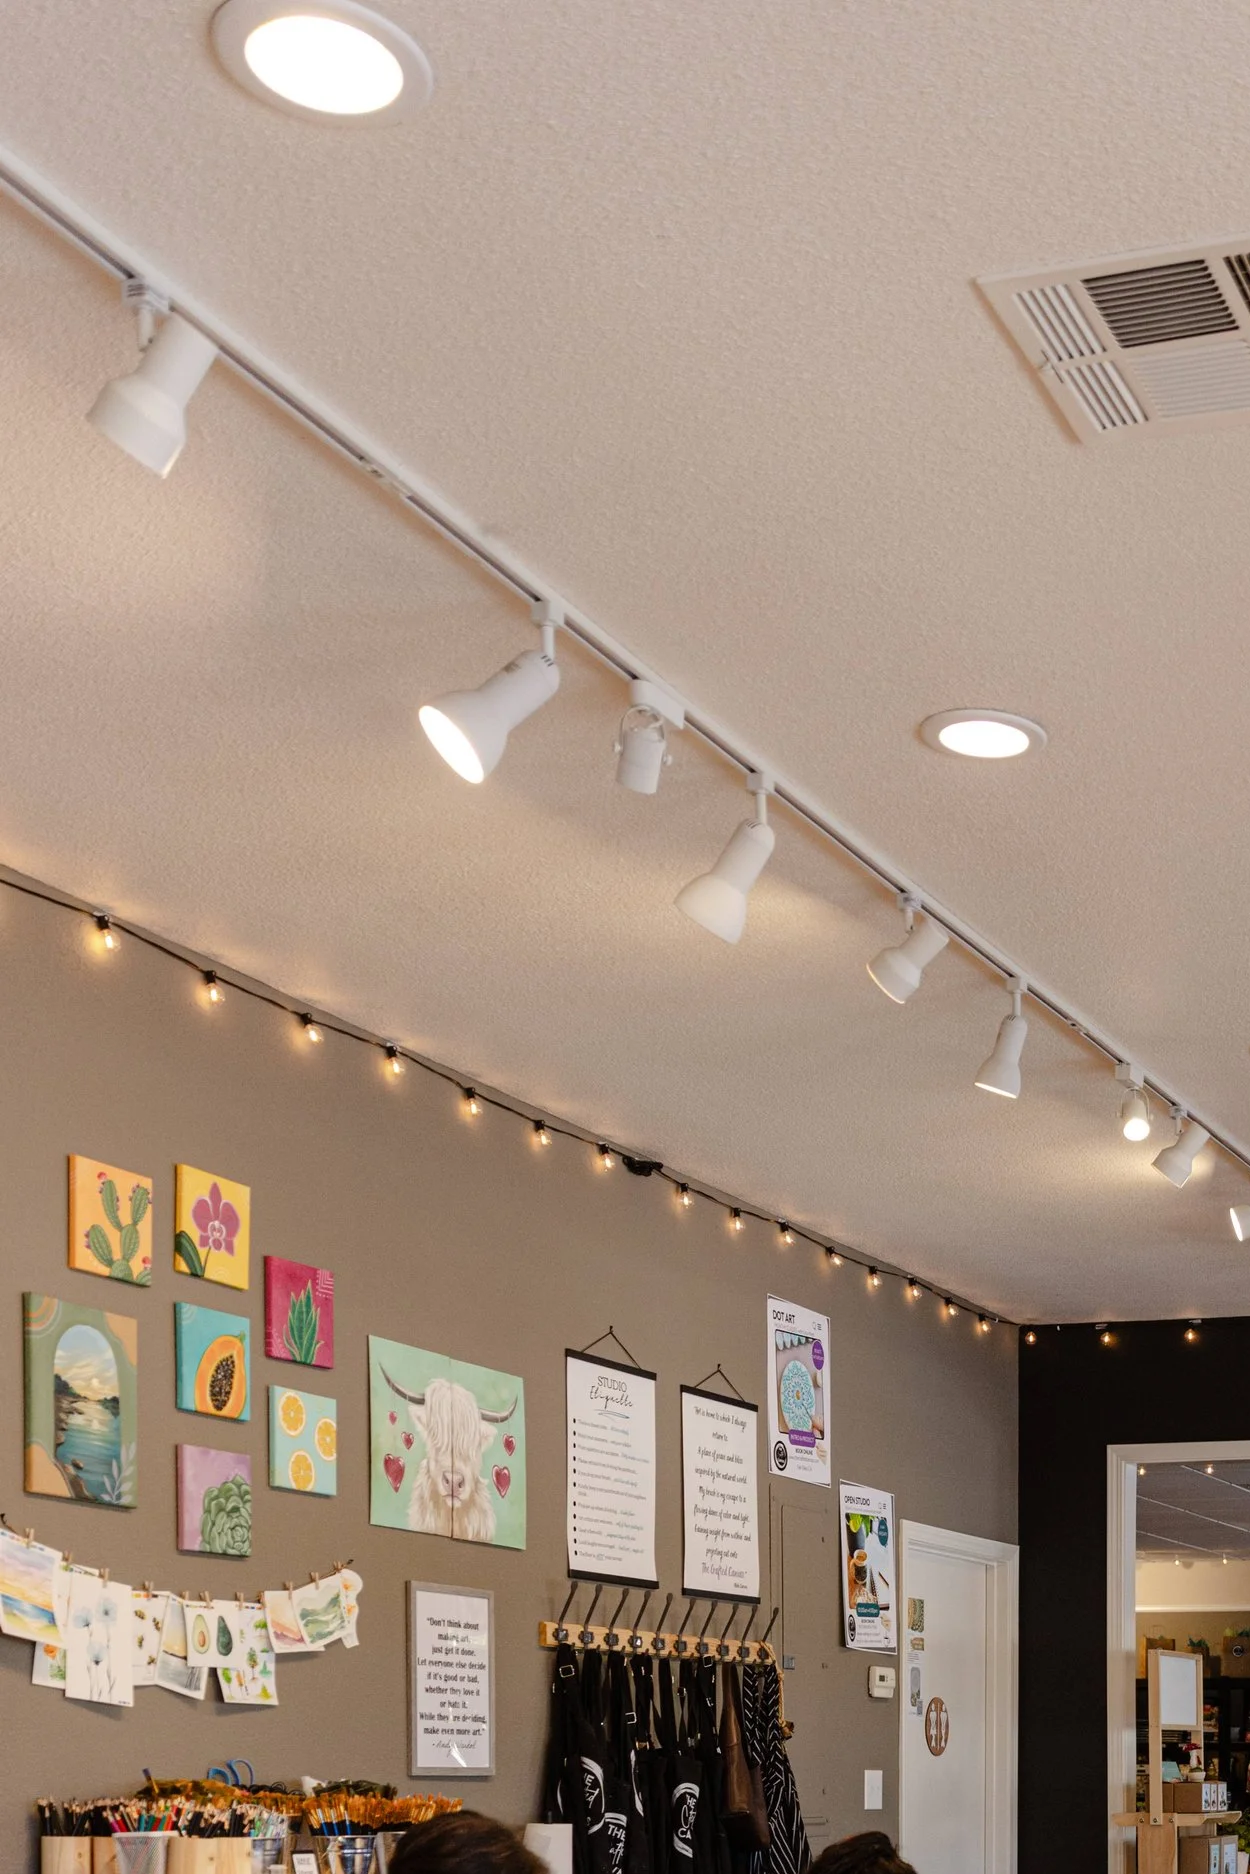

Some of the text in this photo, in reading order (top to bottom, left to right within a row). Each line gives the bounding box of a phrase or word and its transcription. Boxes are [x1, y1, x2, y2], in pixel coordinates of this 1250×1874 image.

[772, 1309, 795, 1324] DOT ART
[597, 1375, 628, 1393] STUDIO
[706, 1409, 716, 1419] home
[720, 1413, 731, 1423] which
[735, 1416, 747, 1433] always
[701, 1447, 712, 1459] place
[711, 1450, 716, 1462] of
[726, 1453, 734, 1463] and
[710, 1469, 716, 1484] by
[721, 1472, 736, 1482] natural
[844, 1495, 870, 1506] OPEN STUDIO
[732, 1512, 740, 1521] and
[743, 1533, 752, 1542] and
[701, 1562, 710, 1574] The
[710, 1563, 728, 1580] Crafted
[426, 1616, 479, 1631] "Don't think about
[437, 1633, 460, 1643] making
[432, 1645, 476, 1657] just get it done.
[417, 1657, 486, 1670] Let everyone else decide
[427, 1671, 432, 1680] if
[432, 1672, 443, 1681] it's
[444, 1673, 458, 1682] good
[425, 1686, 448, 1695] whether
[450, 1686, 461, 1696] they
[463, 1688, 474, 1696] love
[419, 1711, 436, 1721] While
[437, 1713, 449, 1724] they
[423, 1726, 440, 1735] make
[441, 1728, 455, 1736] even
[456, 1728, 471, 1736] more
[607, 1824, 626, 1841] THE
